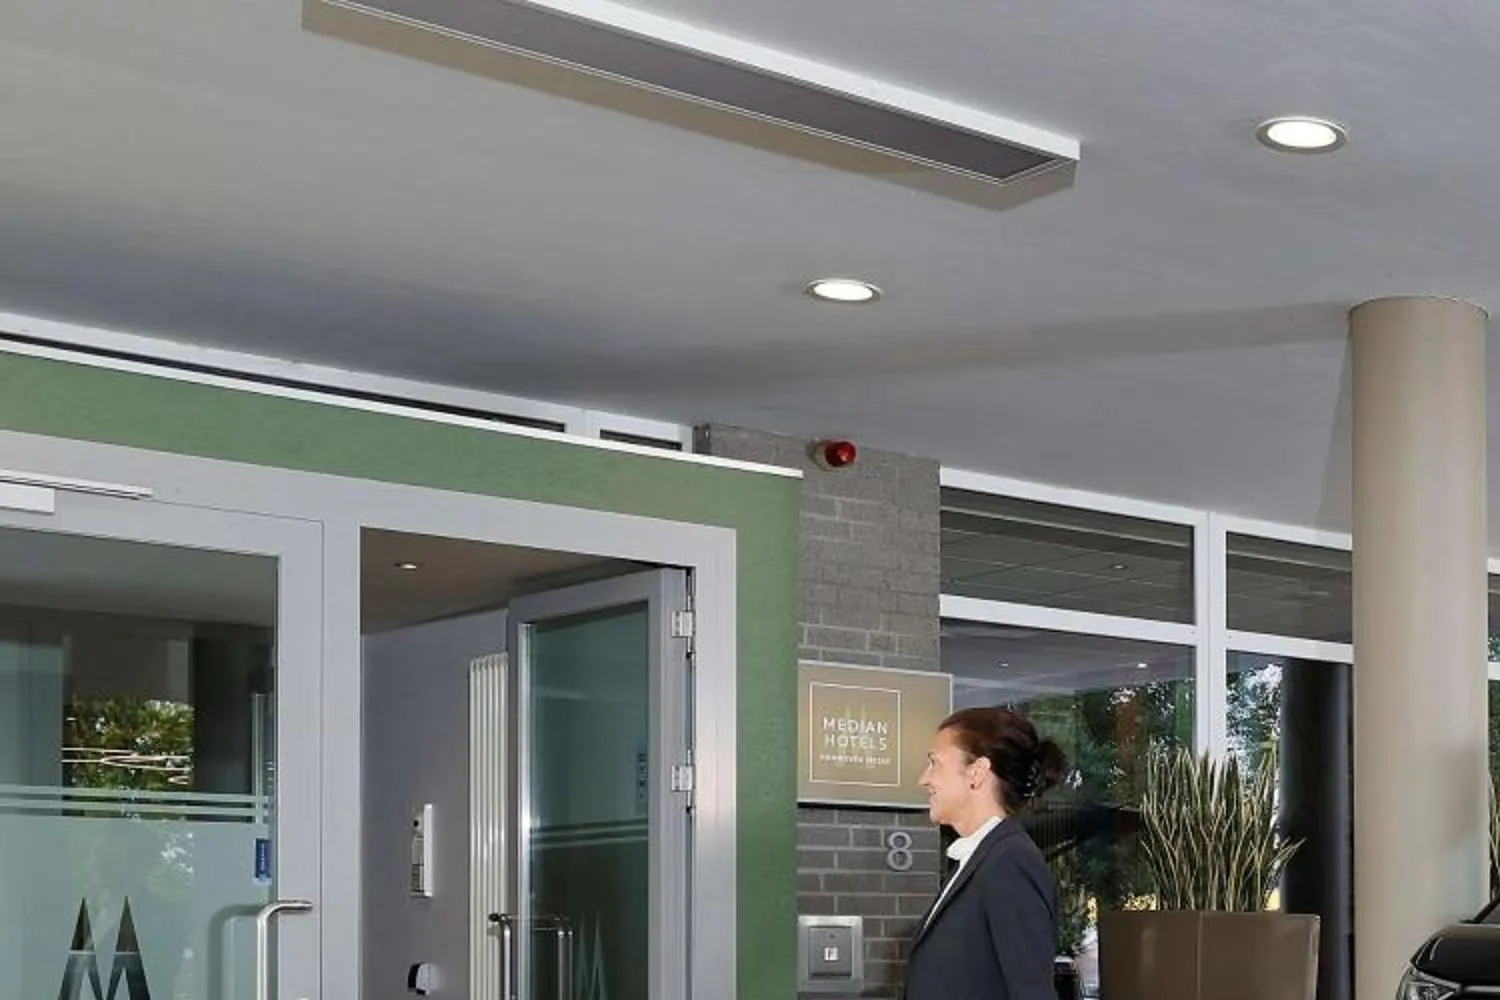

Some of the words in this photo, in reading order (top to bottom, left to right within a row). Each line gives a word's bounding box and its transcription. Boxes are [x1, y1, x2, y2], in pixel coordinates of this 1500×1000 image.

[823, 716, 887, 734] MEDIAN
[824, 734, 887, 751] HOTELS
[887, 831, 913, 871] 8
